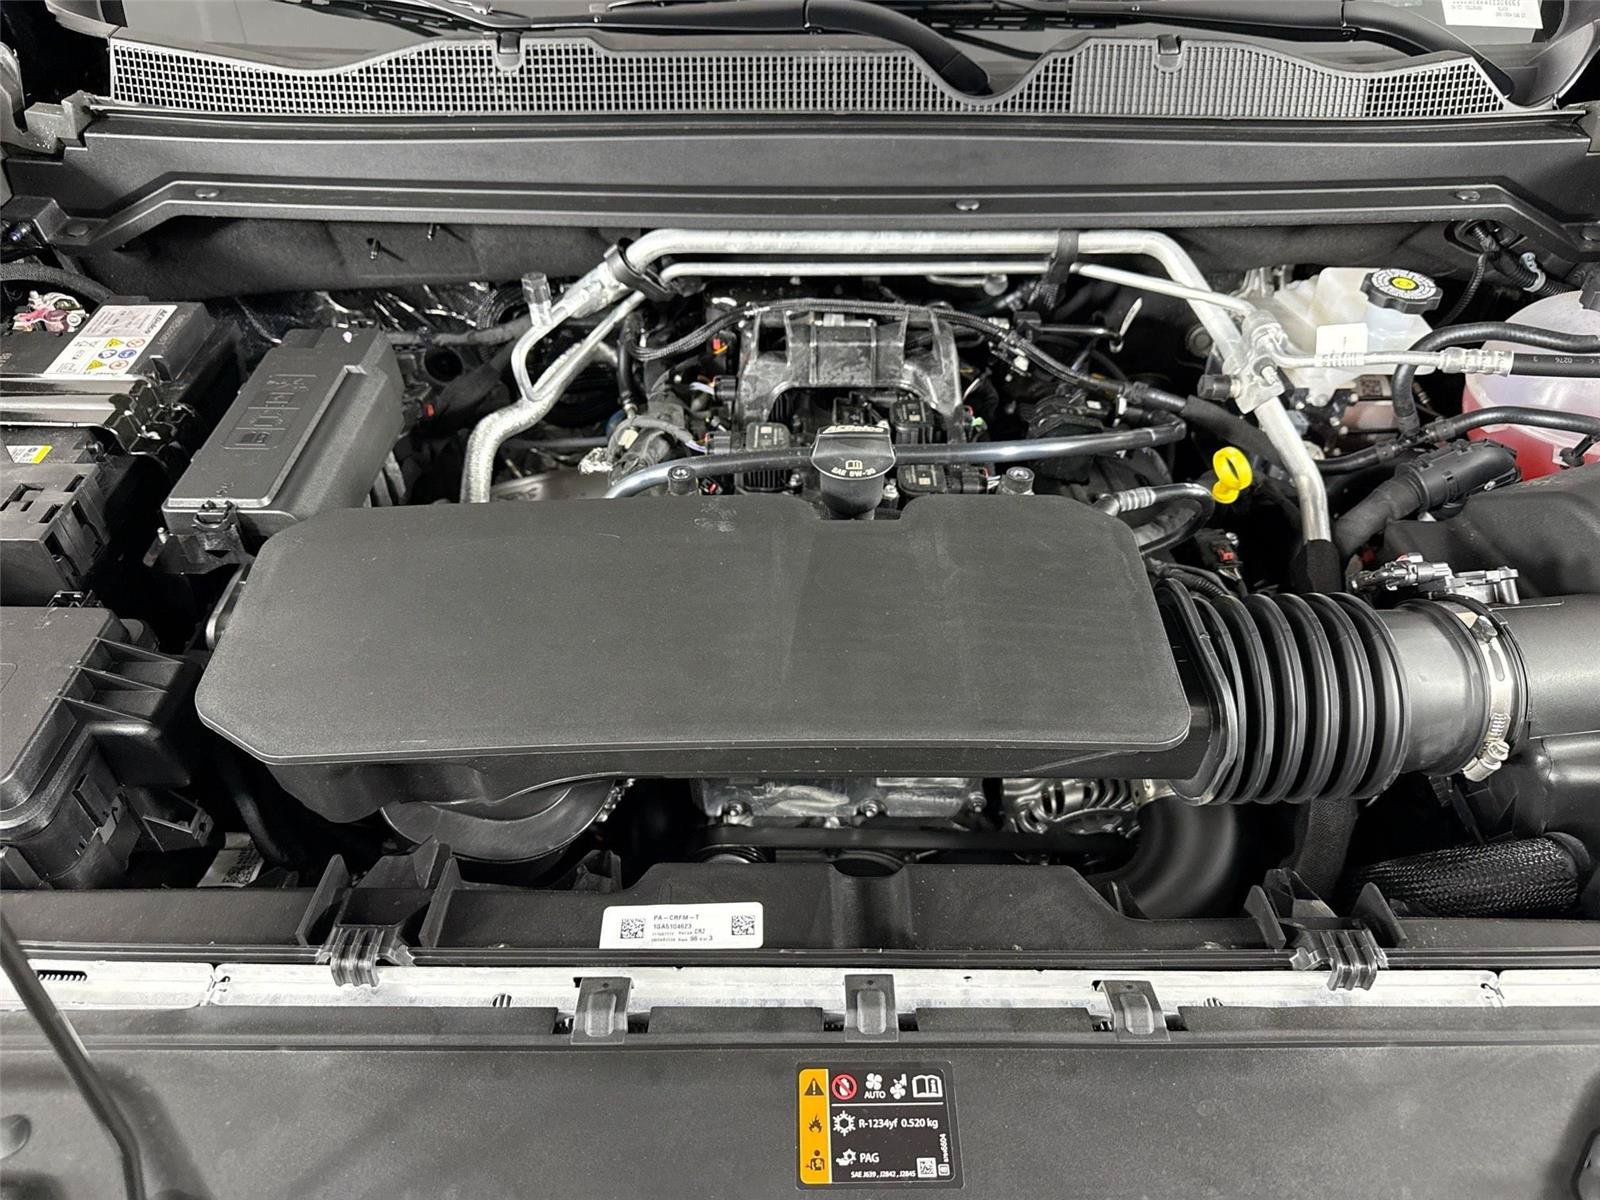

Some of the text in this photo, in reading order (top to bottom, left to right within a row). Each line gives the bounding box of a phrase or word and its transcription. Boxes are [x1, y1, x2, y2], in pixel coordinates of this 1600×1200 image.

[864, 1090, 886, 1099] AUTO
[858, 1117, 939, 1130] R-1234yf 0.520 kg
[859, 1152, 880, 1164] PAG
[850, 1170, 862, 1178] SAE
